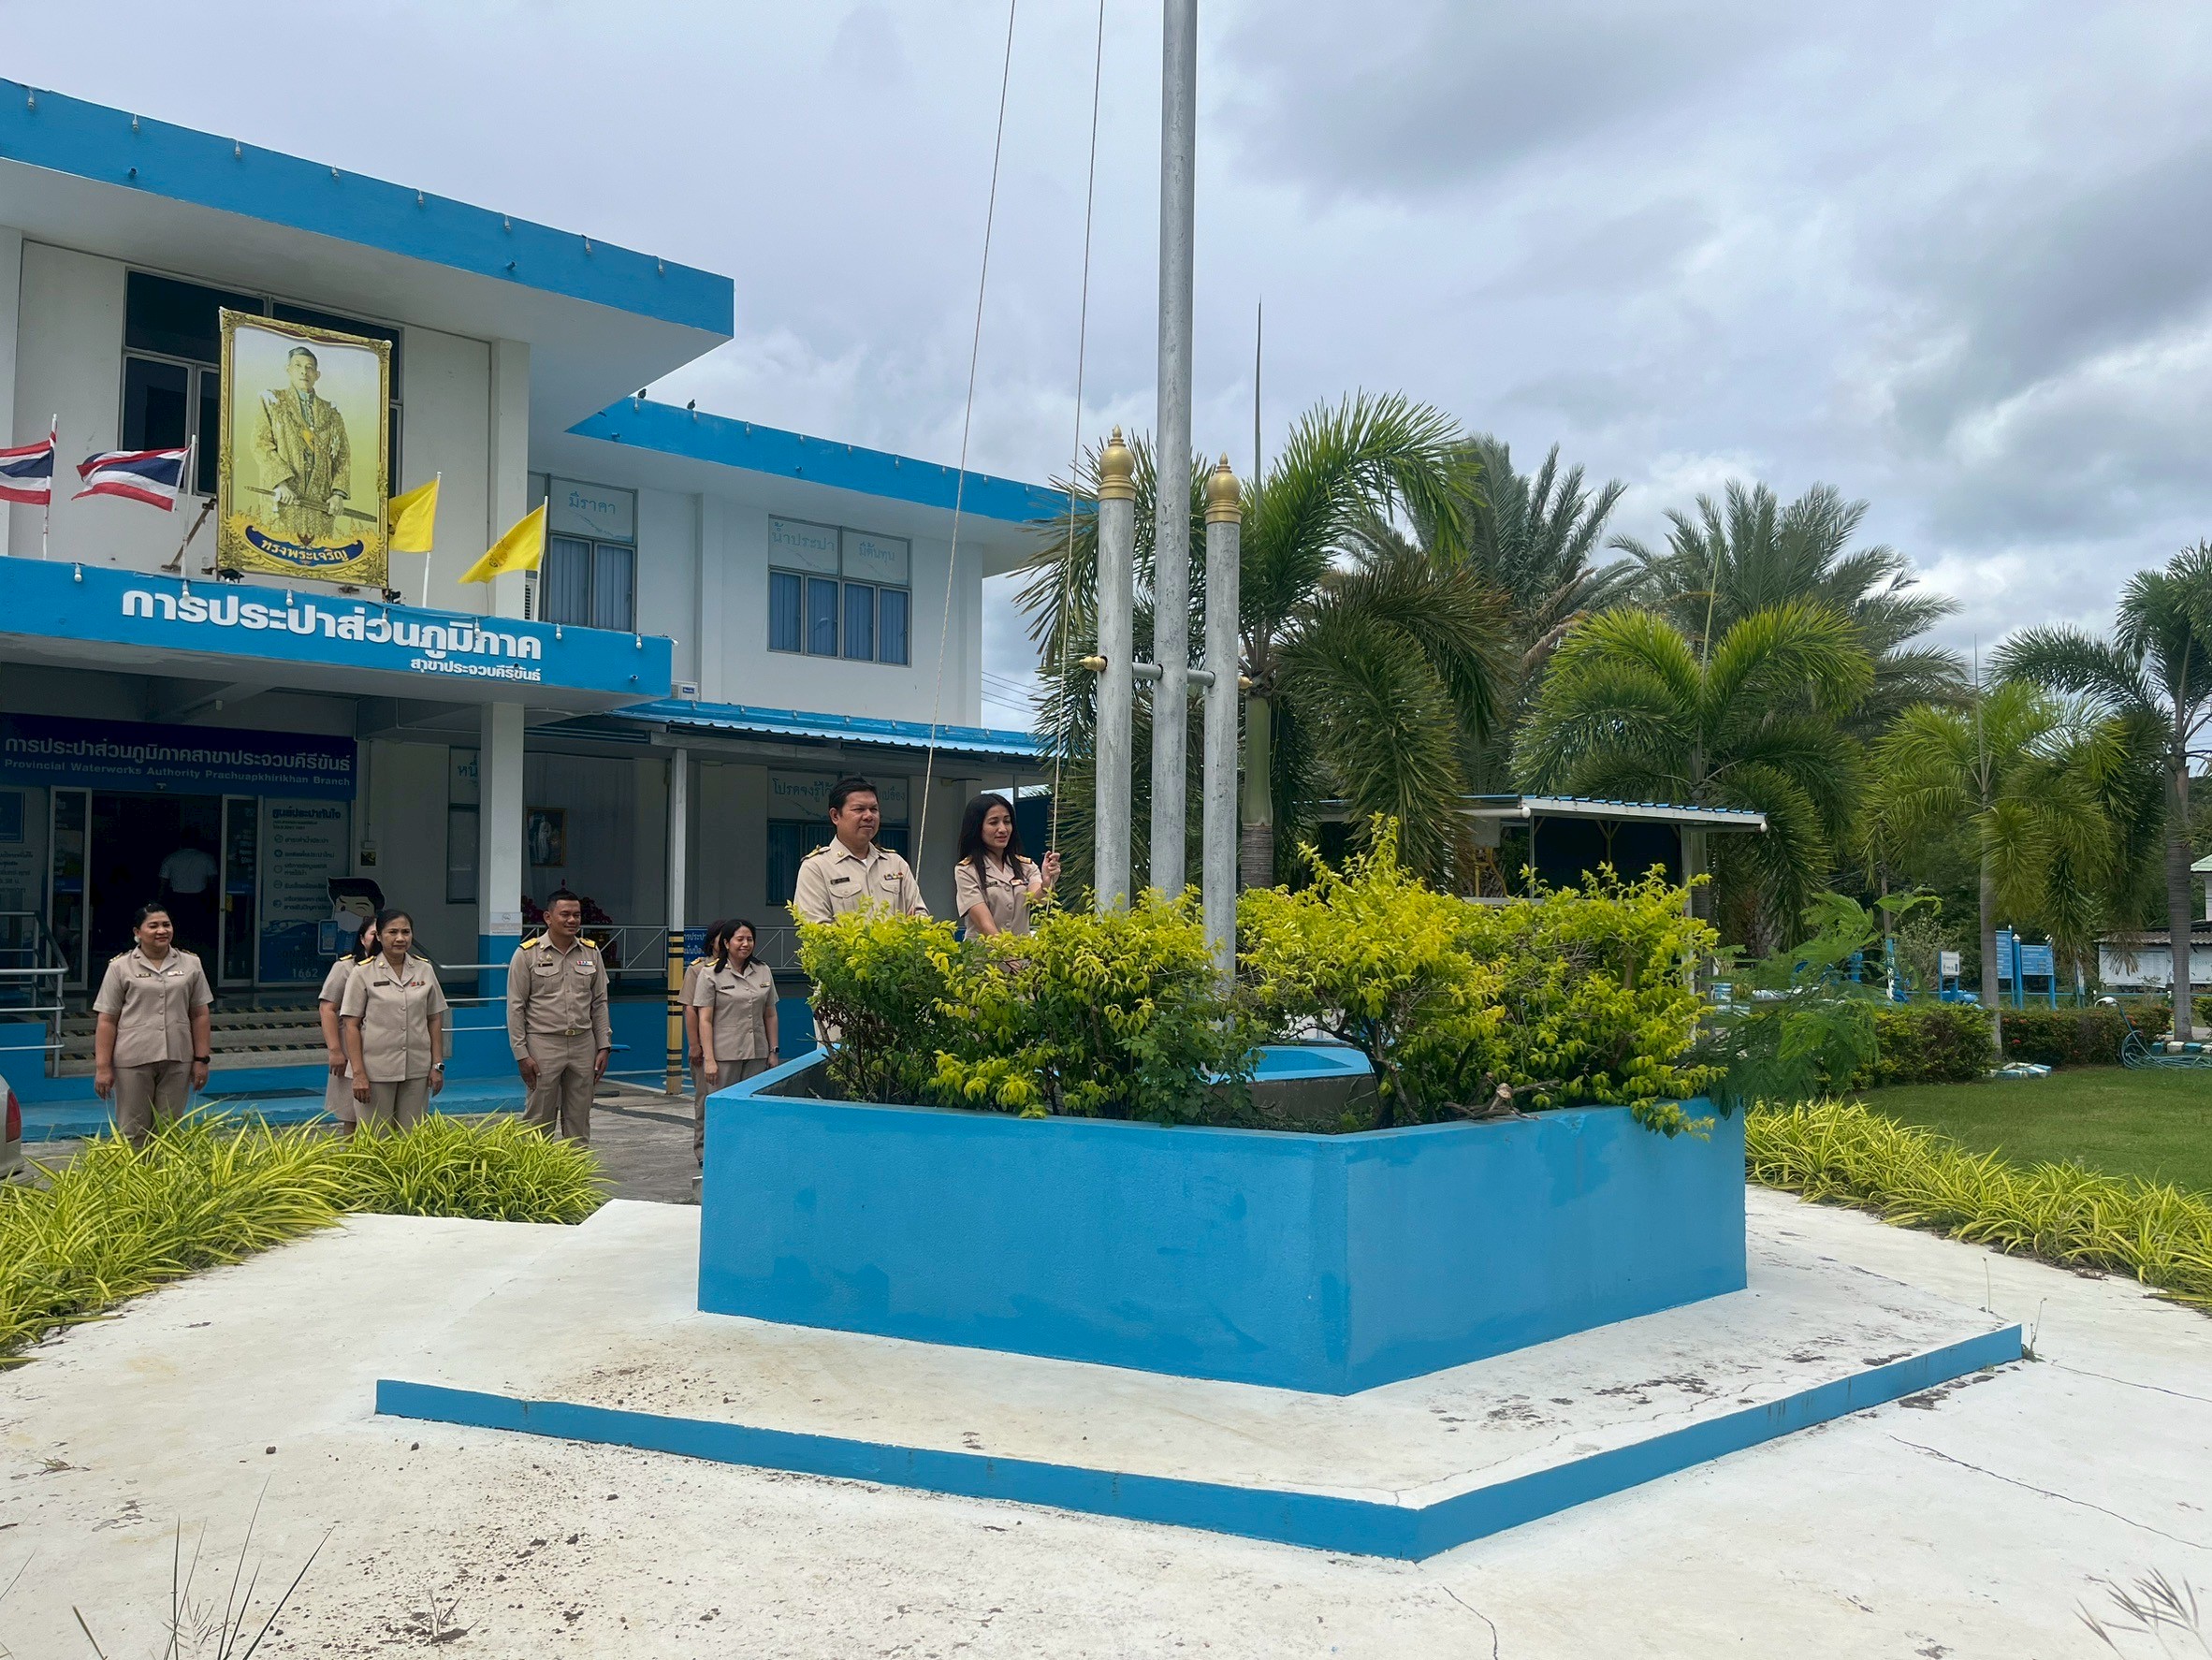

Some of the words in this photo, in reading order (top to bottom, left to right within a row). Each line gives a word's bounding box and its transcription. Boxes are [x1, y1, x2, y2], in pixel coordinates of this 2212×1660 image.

[569, 491, 616, 515] มีราคา
[772, 521, 835, 551] น้ำประปา
[261, 539, 350, 561] ทรงพระเจริญ
[123, 590, 541, 659] การประปาส่วนภูมิภาค
[410, 658, 542, 682] สาขาประจวบคีรีขันธ์
[6, 737, 351, 771] การประปาส่วนภูมิภาคสาขาประจวบคีรีขันธ์
[5, 759, 65, 771] Provincial
[70, 763, 142, 775] Waterworks
[146, 766, 200, 779] Authority
[205, 770, 308, 783] Prachuapkhirikhan
[313, 776, 351, 786] Branch
[292, 968, 319, 978] 1662
